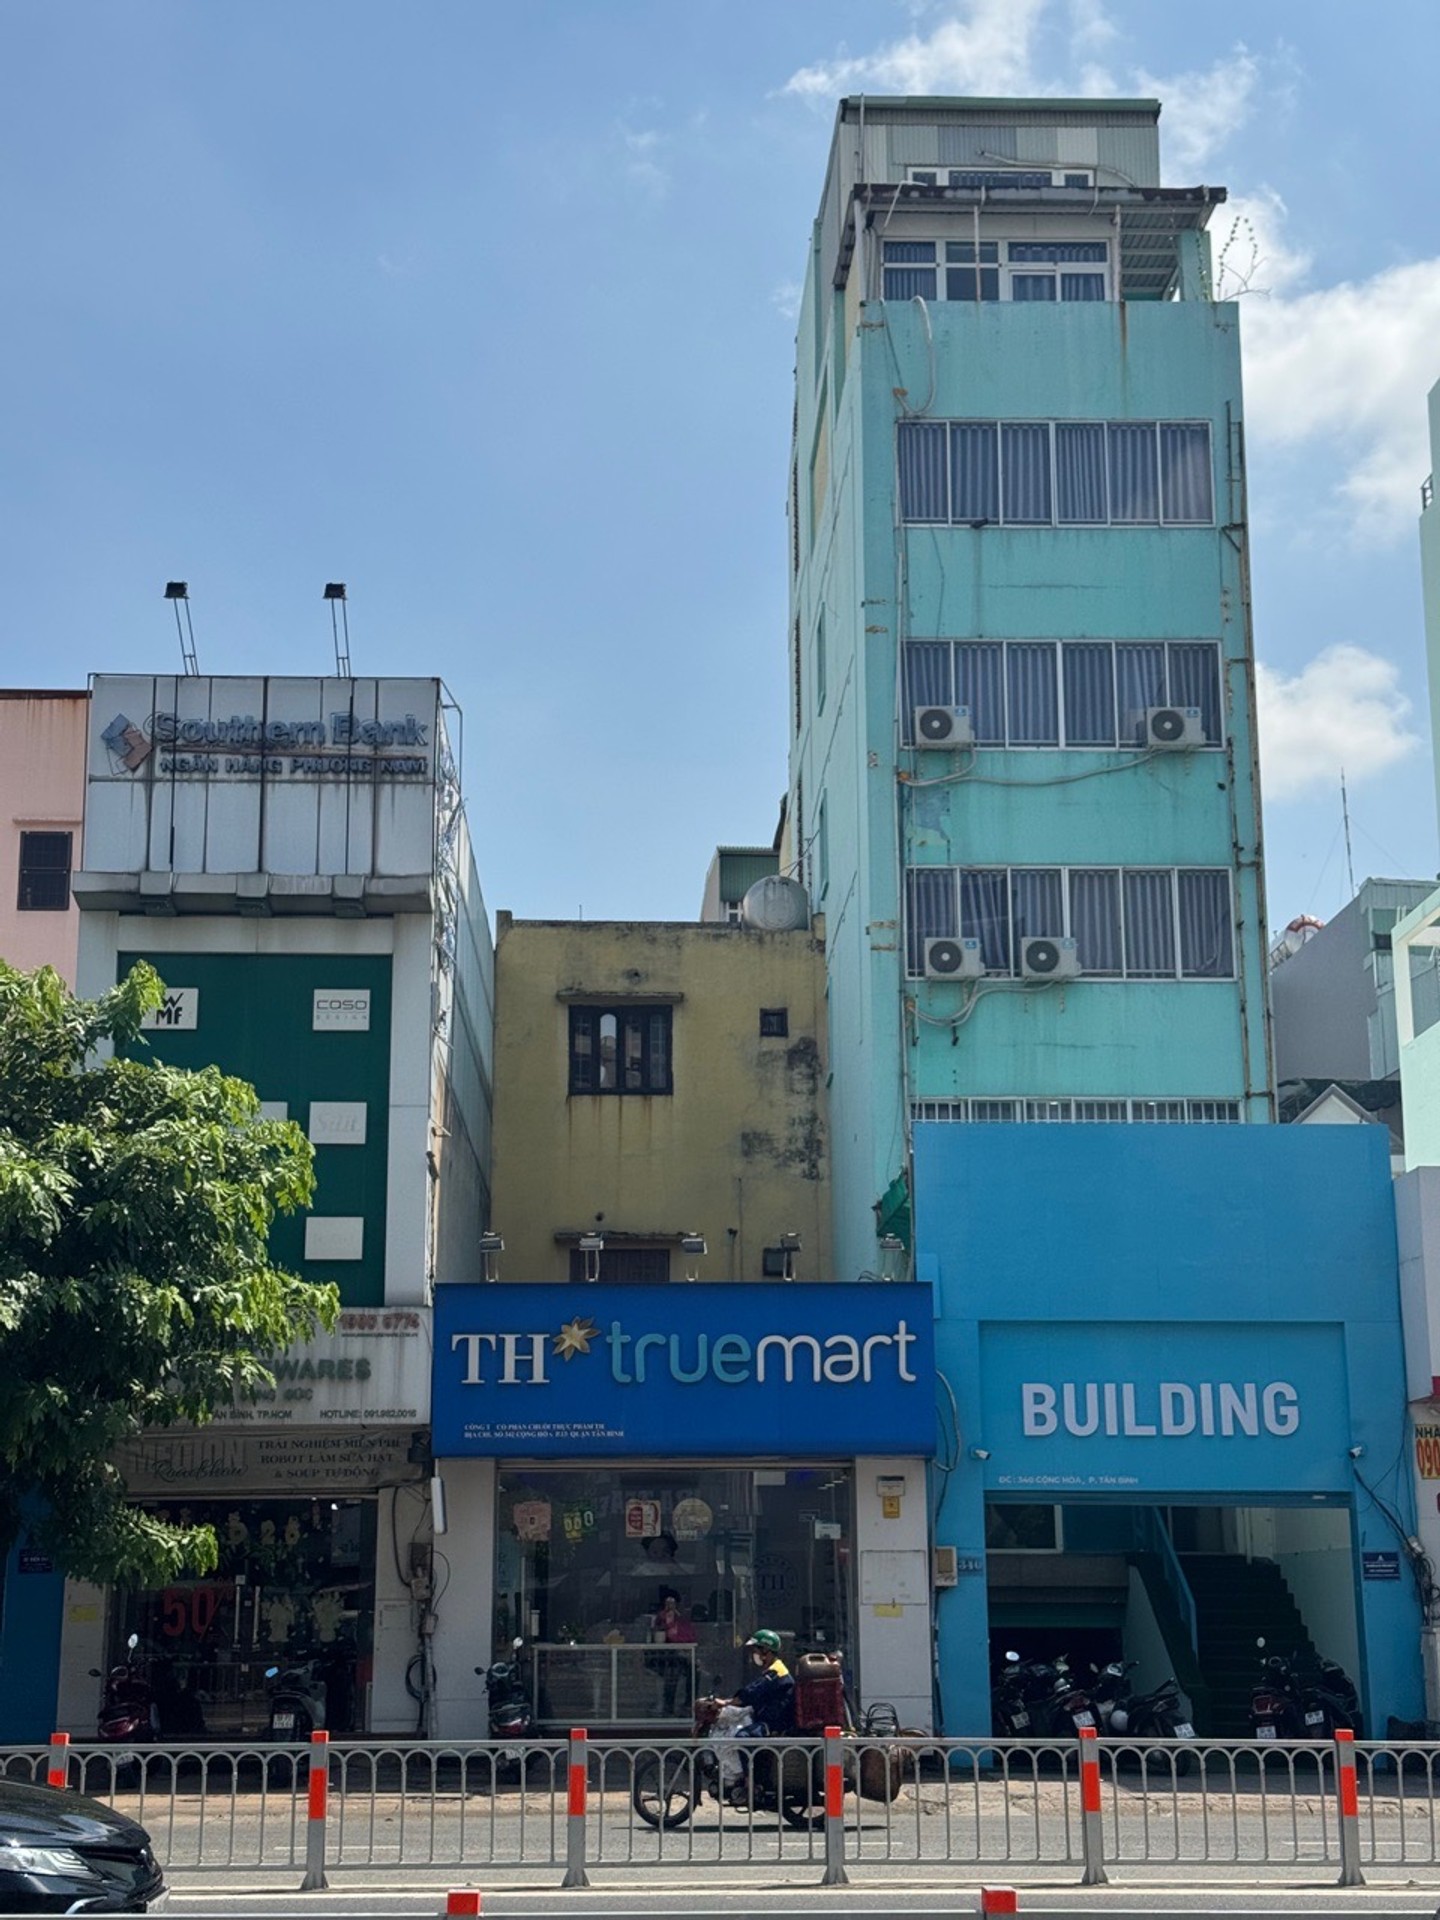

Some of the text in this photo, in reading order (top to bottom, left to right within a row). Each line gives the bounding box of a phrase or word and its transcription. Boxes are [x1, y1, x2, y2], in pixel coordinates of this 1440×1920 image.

[154, 712, 429, 745] Southern Bank
[381, 757, 427, 775] NAM
[451, 1333, 551, 1385] TH
[320, 1409, 362, 1419] HOTLINE:
[1021, 1381, 1300, 1437] BUILDING
[260, 1453, 303, 1464] ROBOT
[286, 1468, 321, 1479] SOUP
